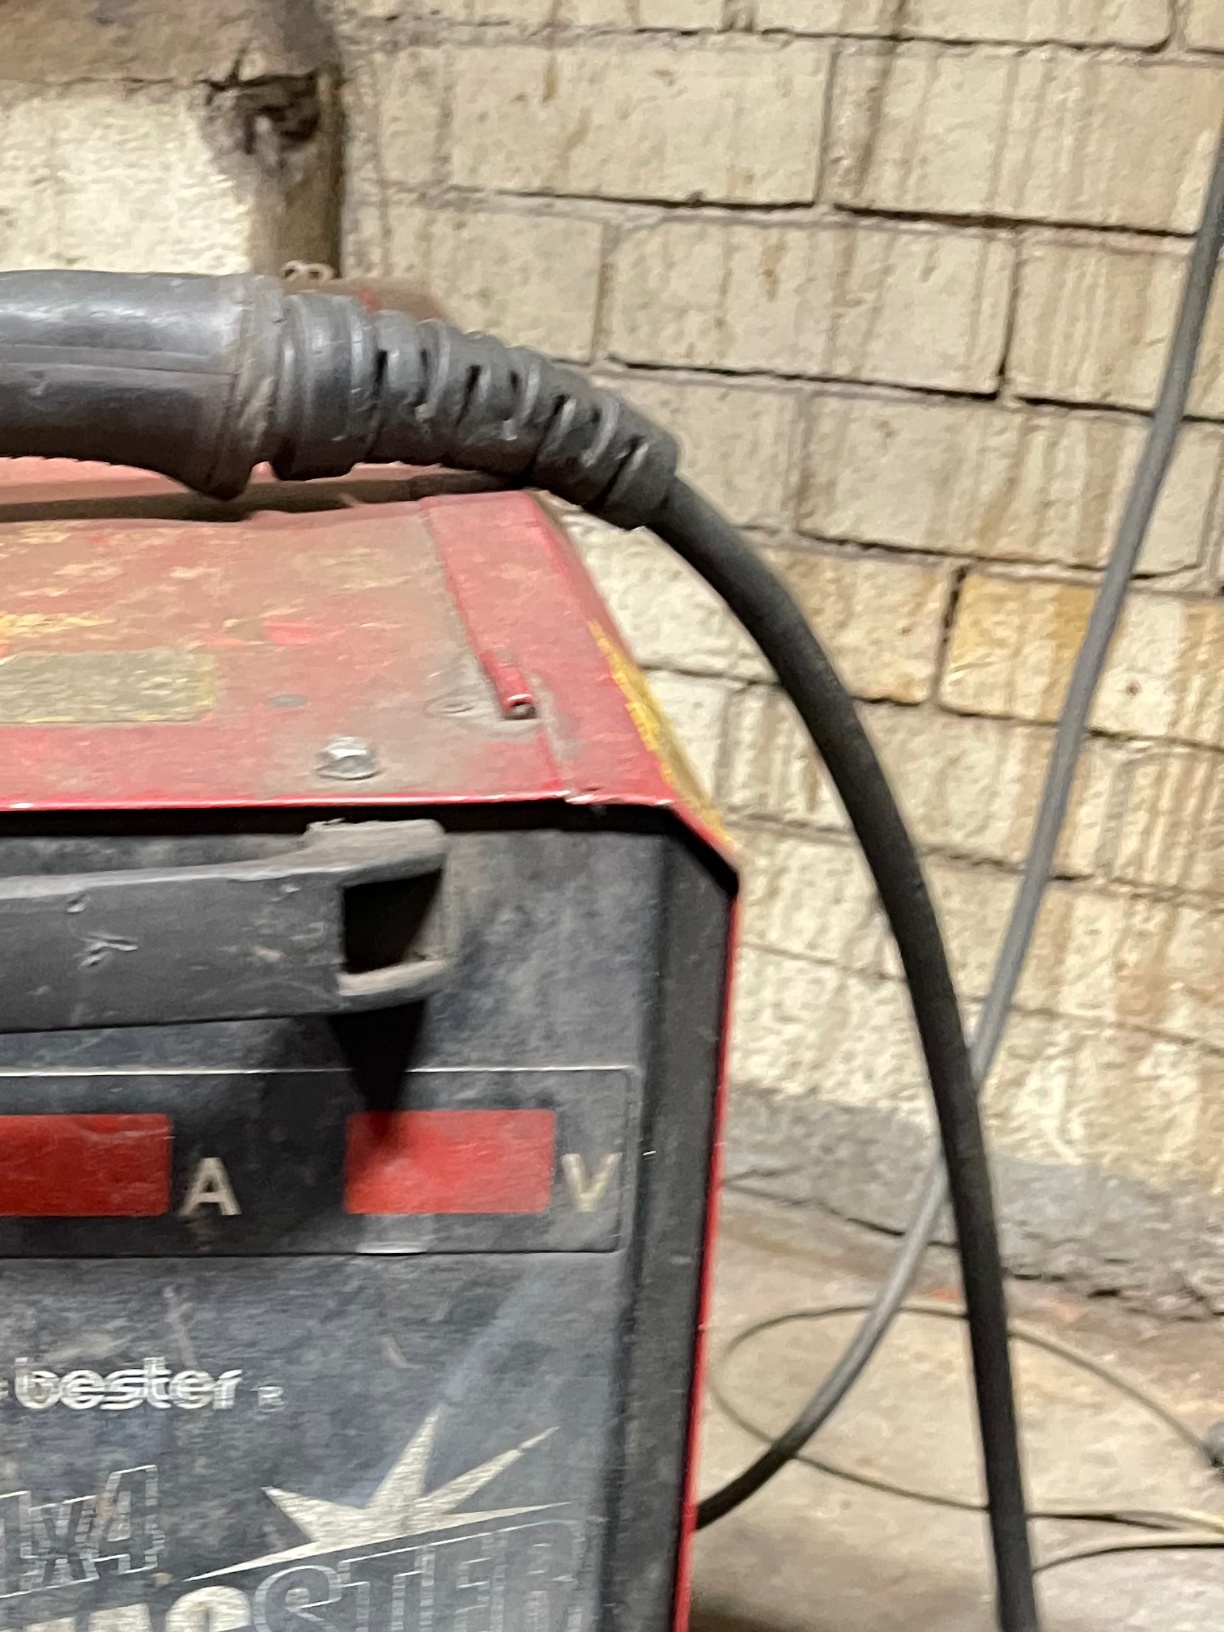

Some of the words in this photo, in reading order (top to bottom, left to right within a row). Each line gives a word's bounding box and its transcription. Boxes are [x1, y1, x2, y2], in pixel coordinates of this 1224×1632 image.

[178, 1156, 242, 1216] A
[561, 1152, 623, 1213] V
[14, 1356, 244, 1410] bester
